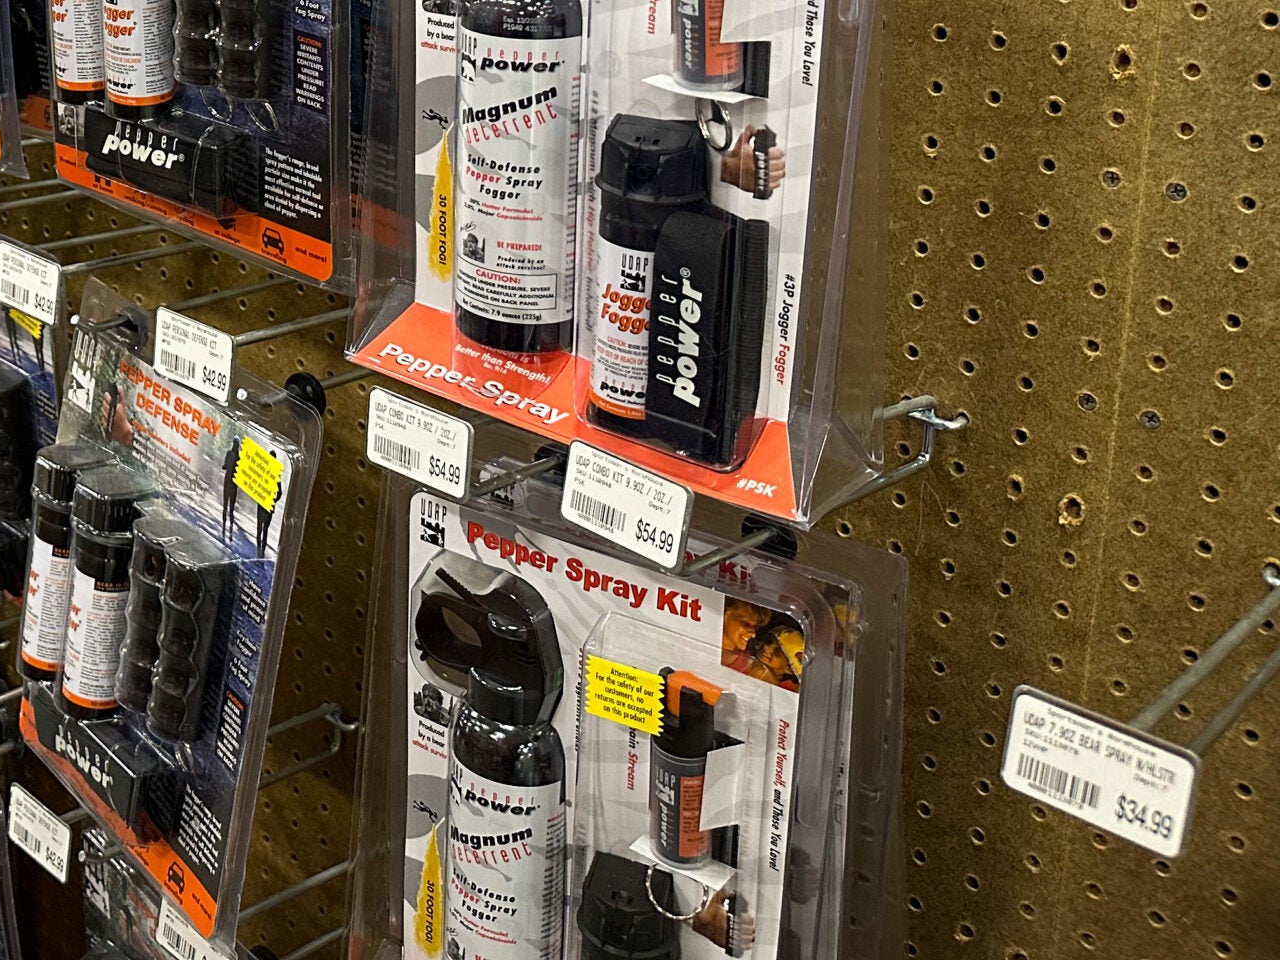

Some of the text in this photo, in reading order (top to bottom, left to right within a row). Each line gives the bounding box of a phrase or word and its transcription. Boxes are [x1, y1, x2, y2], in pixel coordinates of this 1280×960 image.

[427, 17, 455, 29] Produced
[805, 7, 818, 37] Those
[803, 41, 816, 58] You
[480, 57, 562, 73] power
[462, 86, 558, 125] Magnum
[464, 102, 558, 144] deterrent
[466, 166, 543, 189] Pepper Spray
[467, 153, 541, 174] Self-Defense
[480, 184, 520, 200] Fogger
[439, 210, 447, 240] FOOT
[622, 253, 648, 271] UDAP
[476, 269, 521, 284] CAUTION:
[778, 299, 794, 341] Jogger
[455, 343, 551, 384] Better than Strength!
[774, 343, 790, 385] Fogger
[203, 365, 226, 391] $42.99
[380, 343, 570, 425] Pepper Spray
[119, 360, 222, 437] PEPPER SPRAY
[136, 392, 200, 445] DEFENSE
[429, 454, 460, 484] $54.99
[613, 470, 624, 483] KIT
[736, 478, 778, 497] #PSK
[636, 517, 674, 553] $54.99
[467, 521, 703, 622] Pepper Spray Kit
[605, 687, 634, 702] customers,
[627, 703, 652, 717] accepted
[627, 751, 638, 790] Stream
[770, 719, 789, 830] Protect Those
[464, 789, 536, 816] power
[1115, 792, 1173, 839] $34.99
[450, 825, 533, 850] Magnum
[426, 895, 435, 920] FOOT
